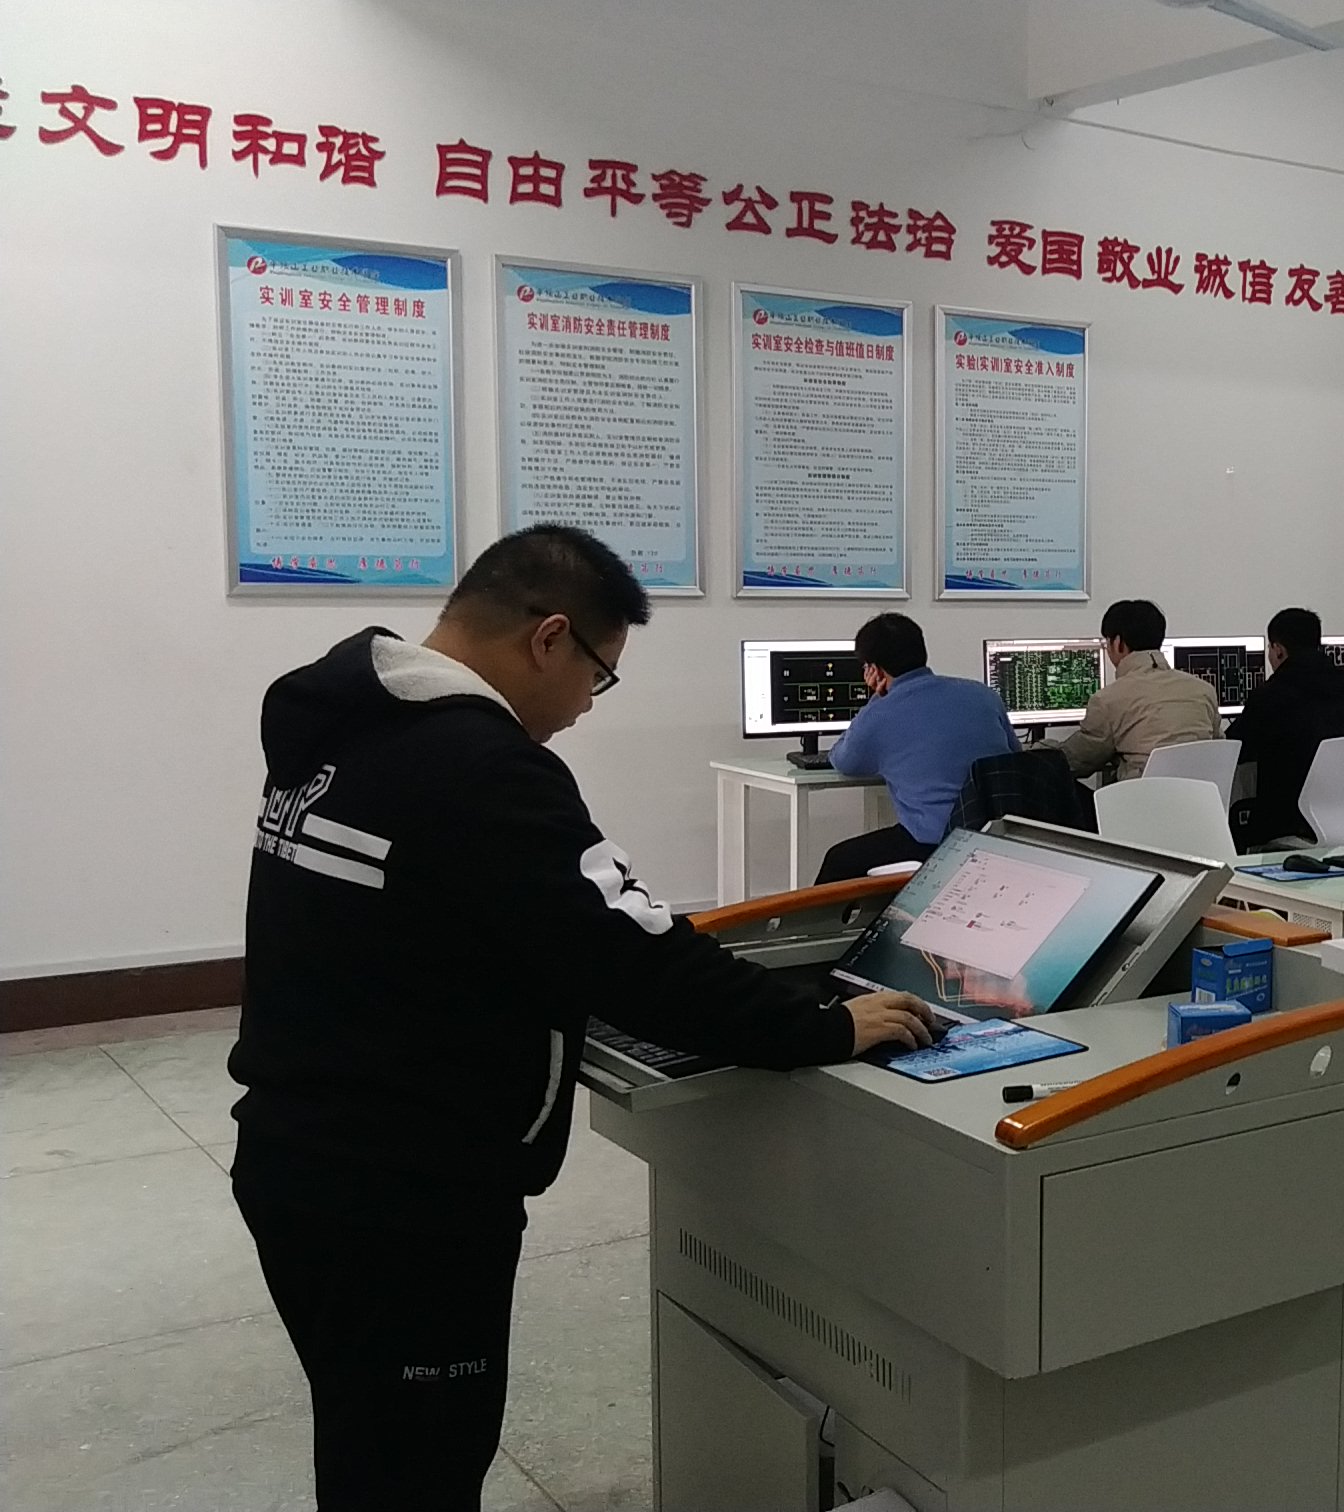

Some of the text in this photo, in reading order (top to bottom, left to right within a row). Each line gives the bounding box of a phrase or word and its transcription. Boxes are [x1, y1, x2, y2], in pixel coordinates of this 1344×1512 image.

[0, 78, 386, 188] 文明和谐
[259, 285, 426, 319] 实训室安全管理制度
[527, 312, 671, 342] 实训室消防安全责任管理制度
[752, 333, 895, 361] 实训室安全检查与值班值日制度
[402, 1358, 487, 1380] NEW STYLE
